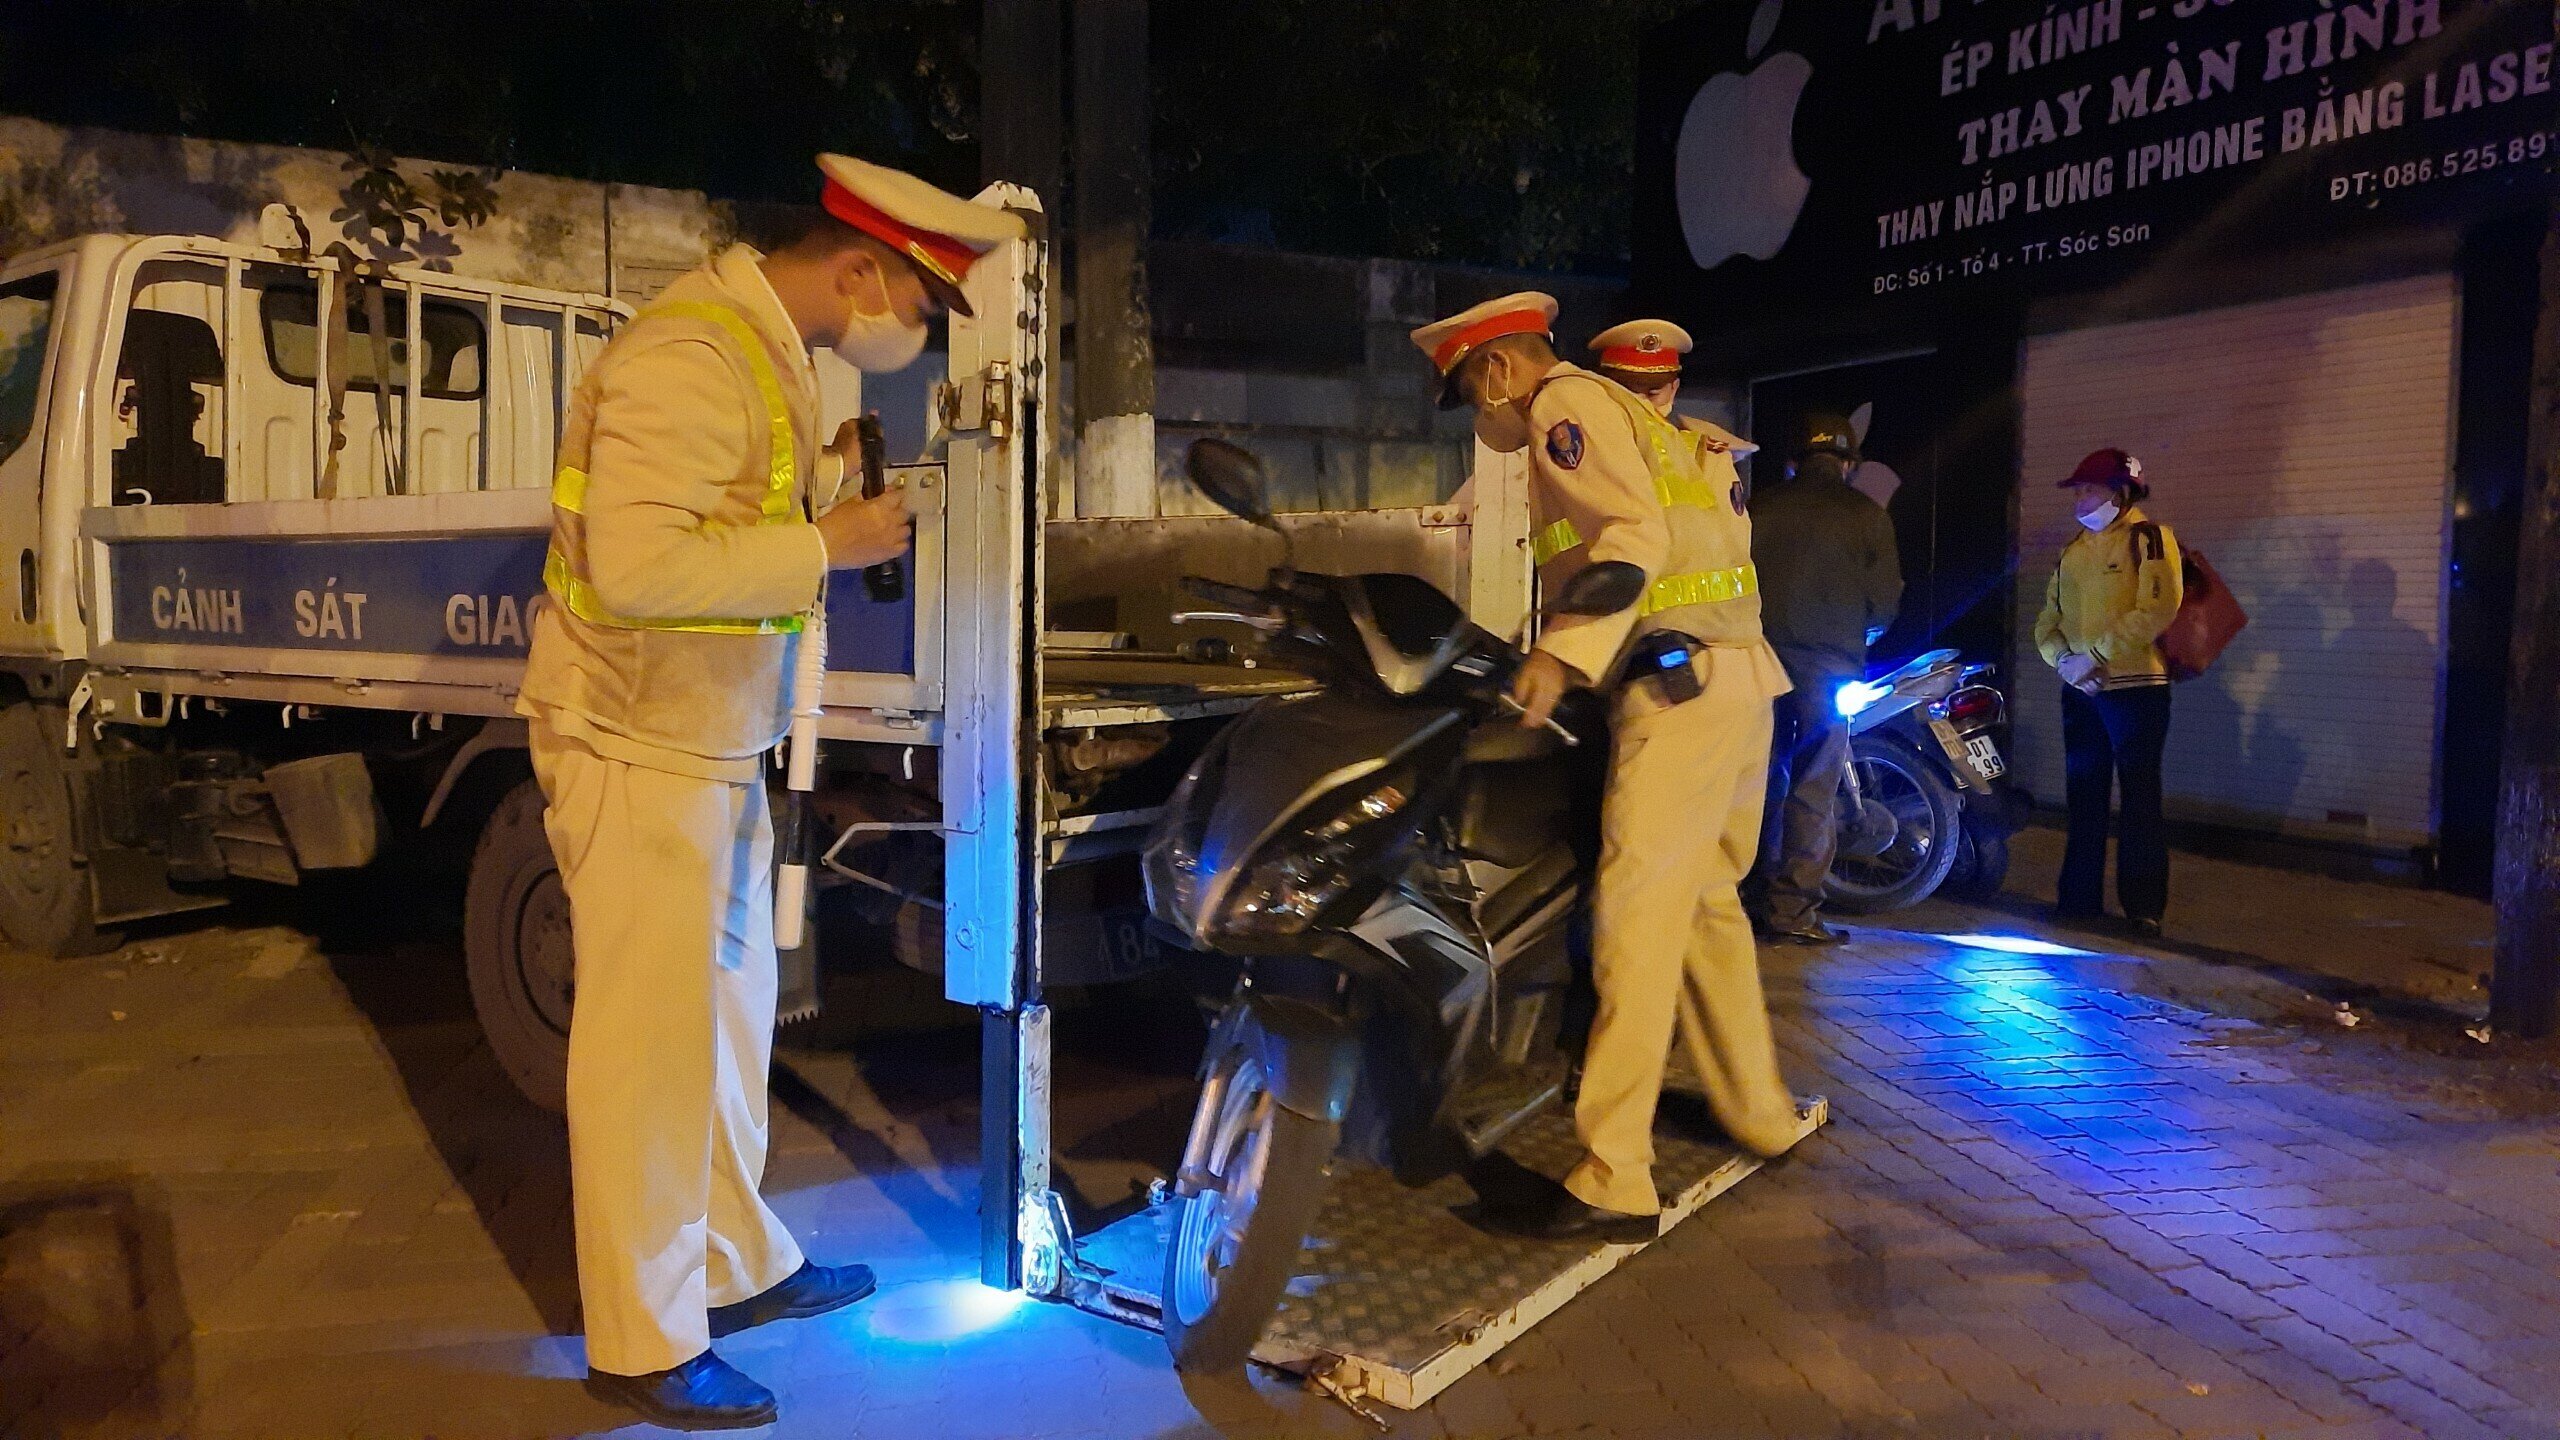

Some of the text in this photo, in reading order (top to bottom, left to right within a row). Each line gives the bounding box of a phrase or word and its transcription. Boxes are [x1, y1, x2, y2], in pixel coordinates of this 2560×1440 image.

[1941, 40, 1994, 97] ÉP
[2007, 0, 2122, 75] KÍNH
[1958, 0, 2443, 165] THAY MÀN HÌNH
[1877, 200, 1944, 249] THAY
[1954, 169, 2017, 231] NẮP
[2026, 156, 2113, 213] LƯNG
[2127, 116, 2265, 189] IPHONE
[1989, 252, 1999, 270] 4
[2022, 242, 2052, 265] TT.
[2059, 230, 2099, 257] Sóc
[2107, 223, 2150, 247] Sơn
[150, 568, 243, 634] CẢNH
[294, 577, 367, 641] SÁT
